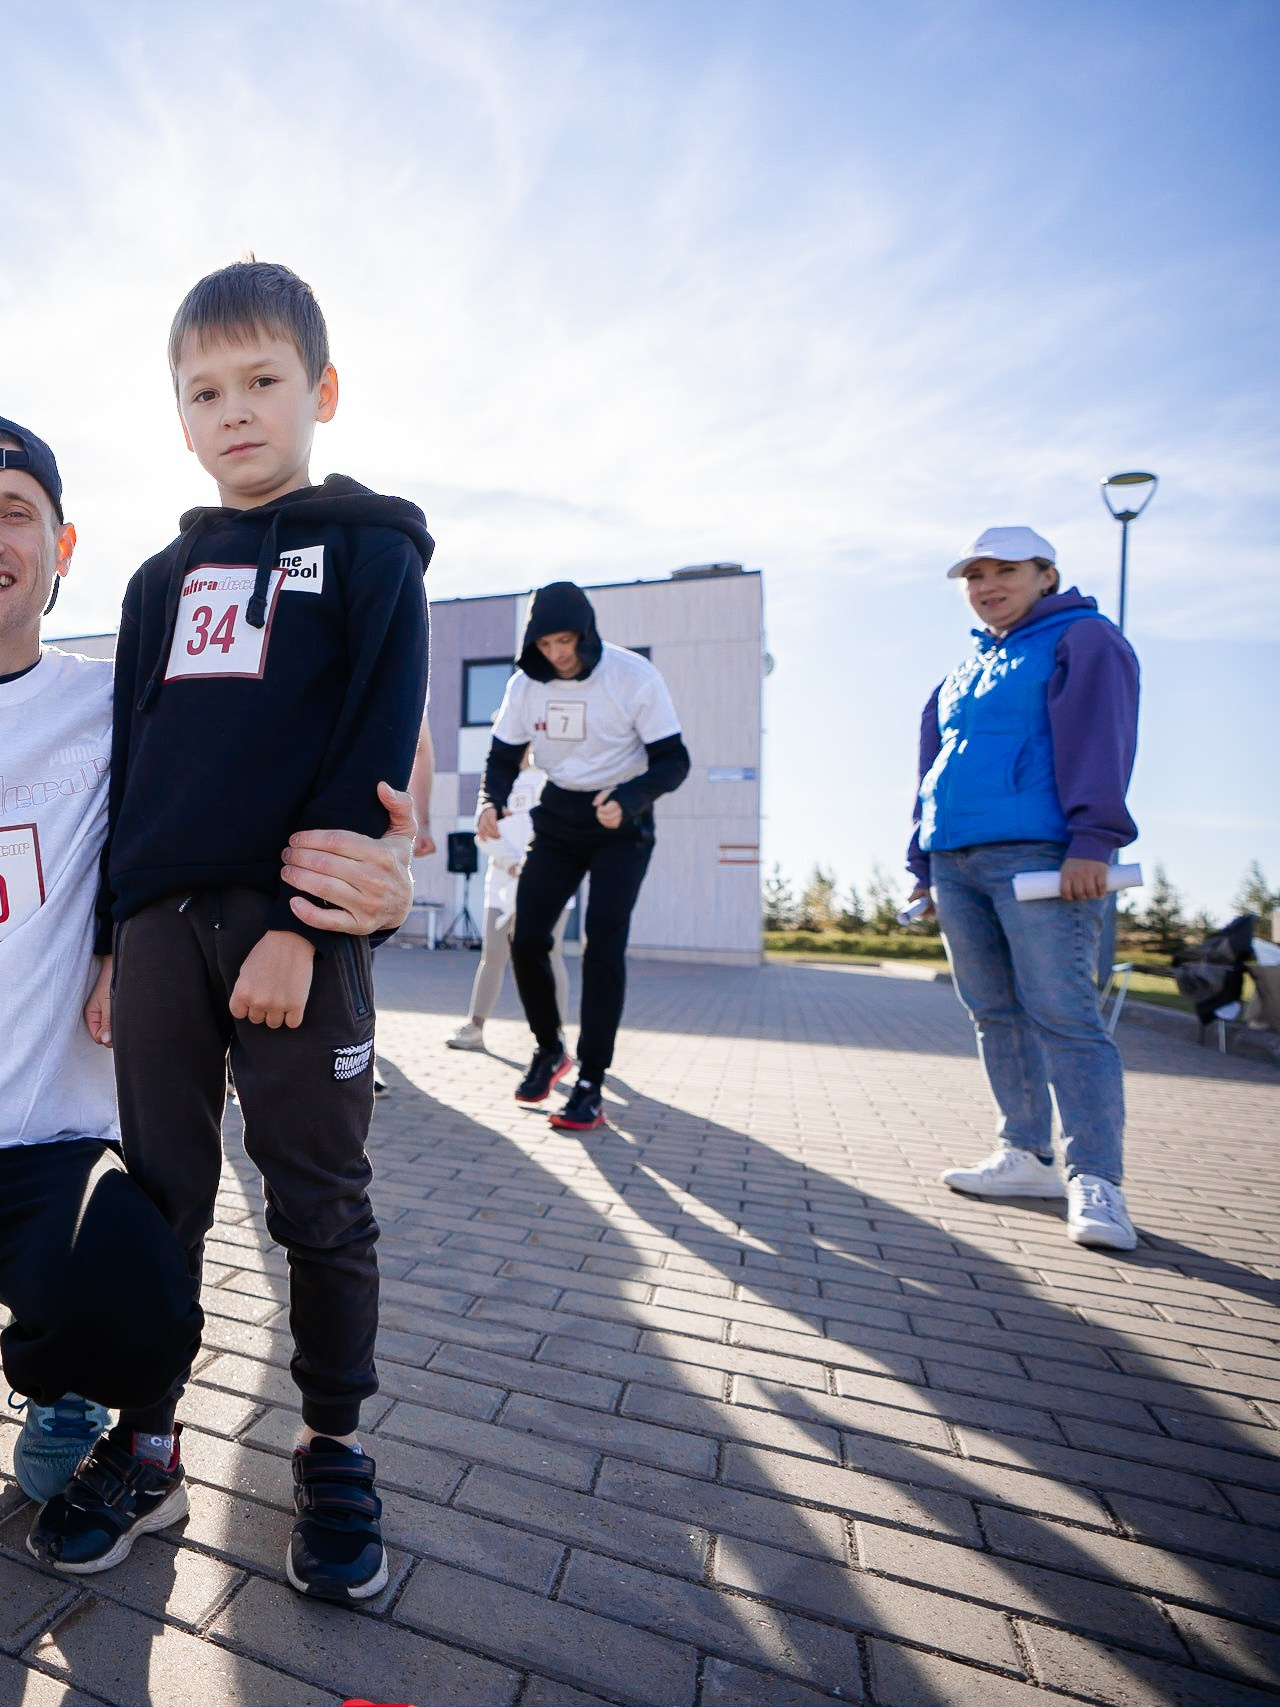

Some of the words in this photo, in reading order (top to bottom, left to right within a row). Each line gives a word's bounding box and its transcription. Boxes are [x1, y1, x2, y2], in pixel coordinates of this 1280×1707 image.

[183, 577, 272, 597] ultradec
[187, 605, 239, 655] 34
[560, 715, 570, 733] 7
